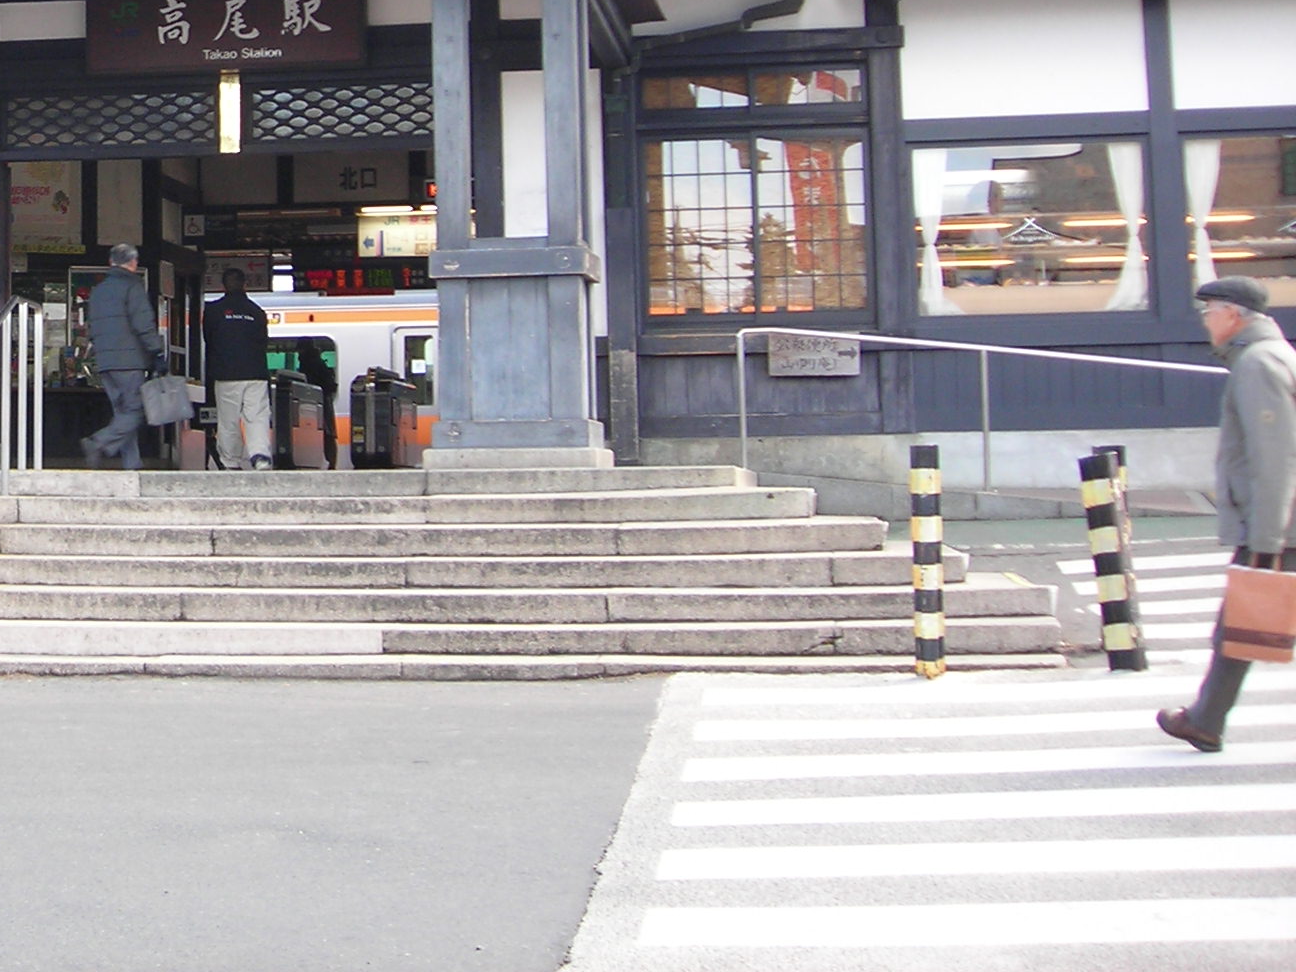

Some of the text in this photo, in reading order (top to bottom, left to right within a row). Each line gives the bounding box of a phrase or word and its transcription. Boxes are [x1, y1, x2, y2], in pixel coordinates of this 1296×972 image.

[111, 2, 139, 19] JR
[203, 46, 283, 60] Takao Station
[340, 166, 377, 190] 北口
[384, 216, 401, 226] JR
